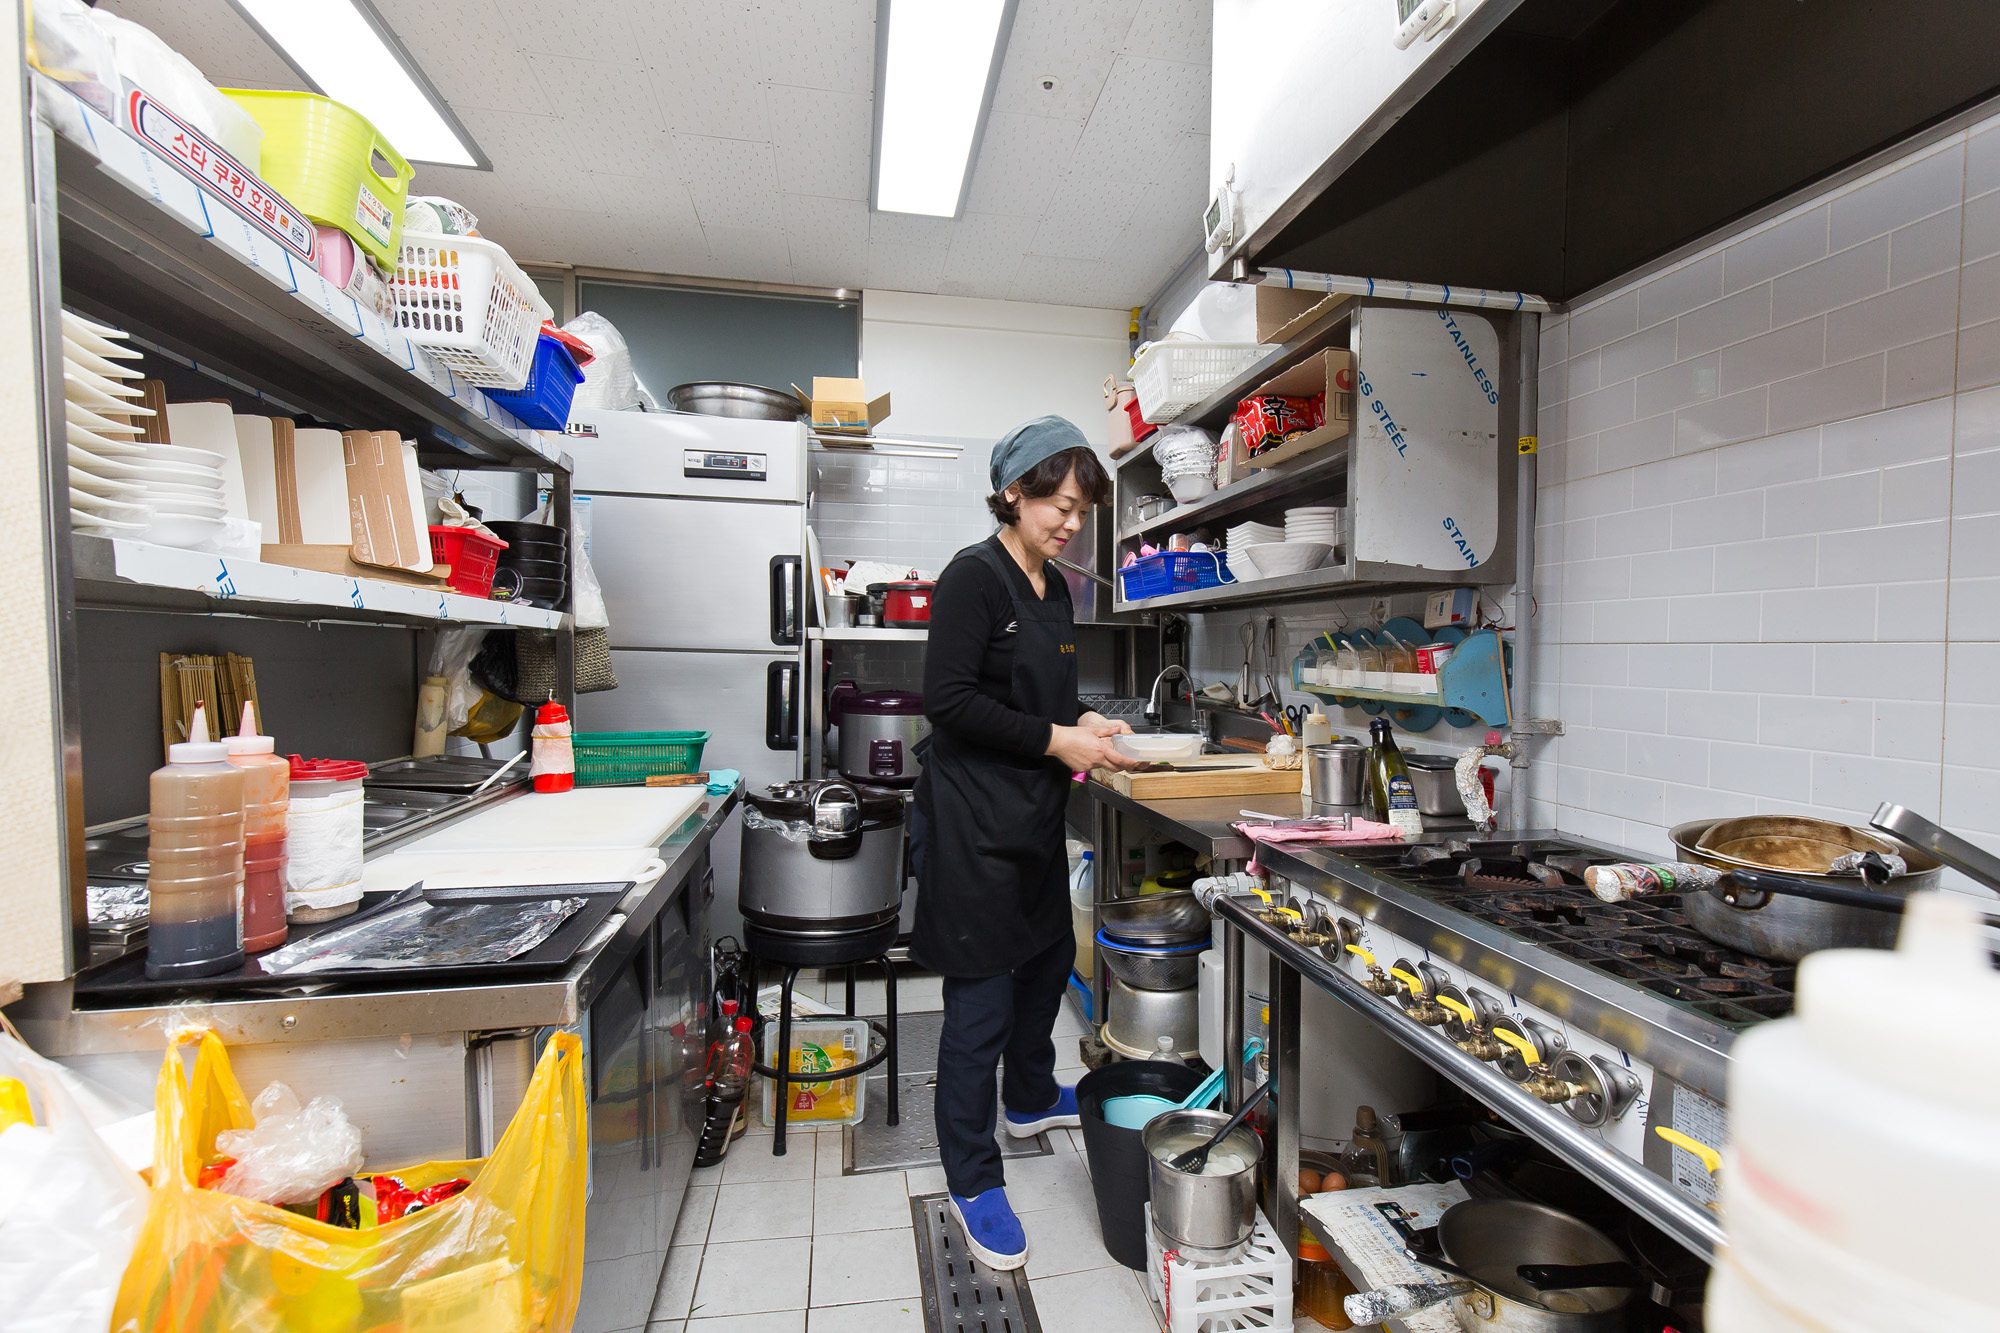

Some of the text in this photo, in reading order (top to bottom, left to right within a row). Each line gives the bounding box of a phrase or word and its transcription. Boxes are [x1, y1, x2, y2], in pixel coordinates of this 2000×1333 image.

[172, 133, 278, 224] 스타 쿠킹 호일
[1437, 310, 1499, 405] STAINLESS
[1261, 396, 1297, 432] 辛
[1371, 399, 1409, 458] STEEL
[1442, 516, 1480, 568] STAIN
